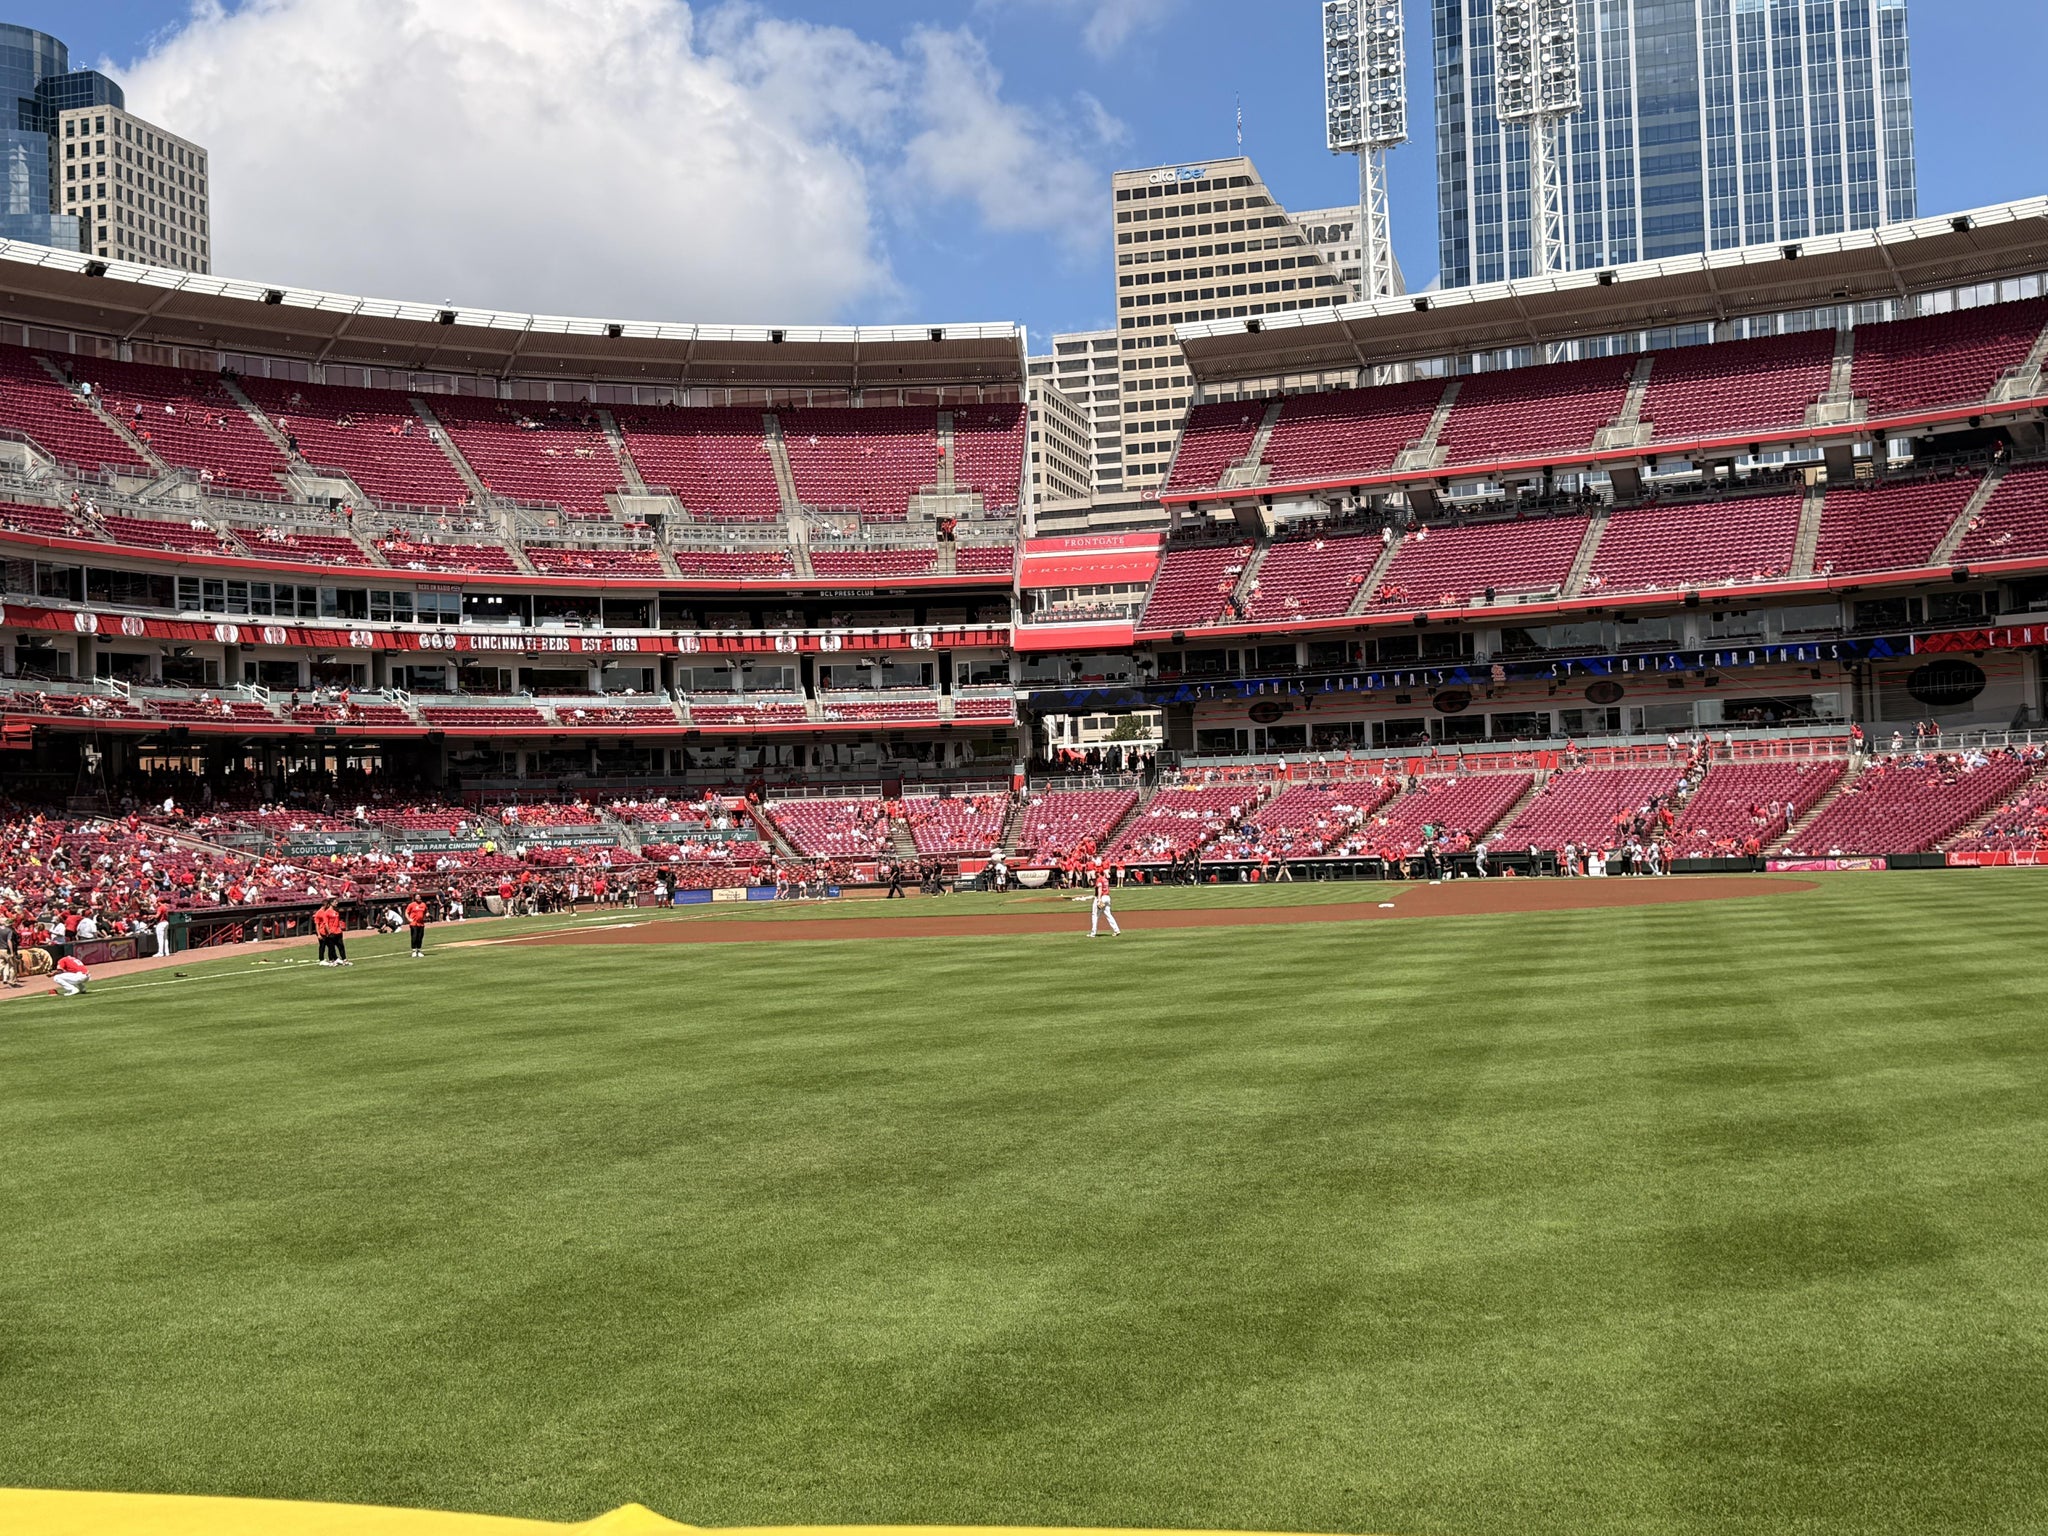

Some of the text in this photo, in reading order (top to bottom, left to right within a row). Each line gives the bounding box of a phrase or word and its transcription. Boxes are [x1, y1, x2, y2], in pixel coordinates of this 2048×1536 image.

[1064, 537, 1125, 547] FRONTGATE
[1027, 562, 1155, 574] FRONTGATE
[222, 625, 231, 642] 8
[470, 636, 638, 652] CINCINNATI REDS EST. 1869
[1551, 644, 1839, 678] ST. LOUIS CARDINALS
[1196, 670, 1444, 699] ST. LOUIS CARDINALS
[573, 838, 615, 846] CINCINNATI
[672, 834, 702, 842] SCOUTS
[291, 846, 318, 855] SCOUTS
[318, 846, 336, 854] CLUB
